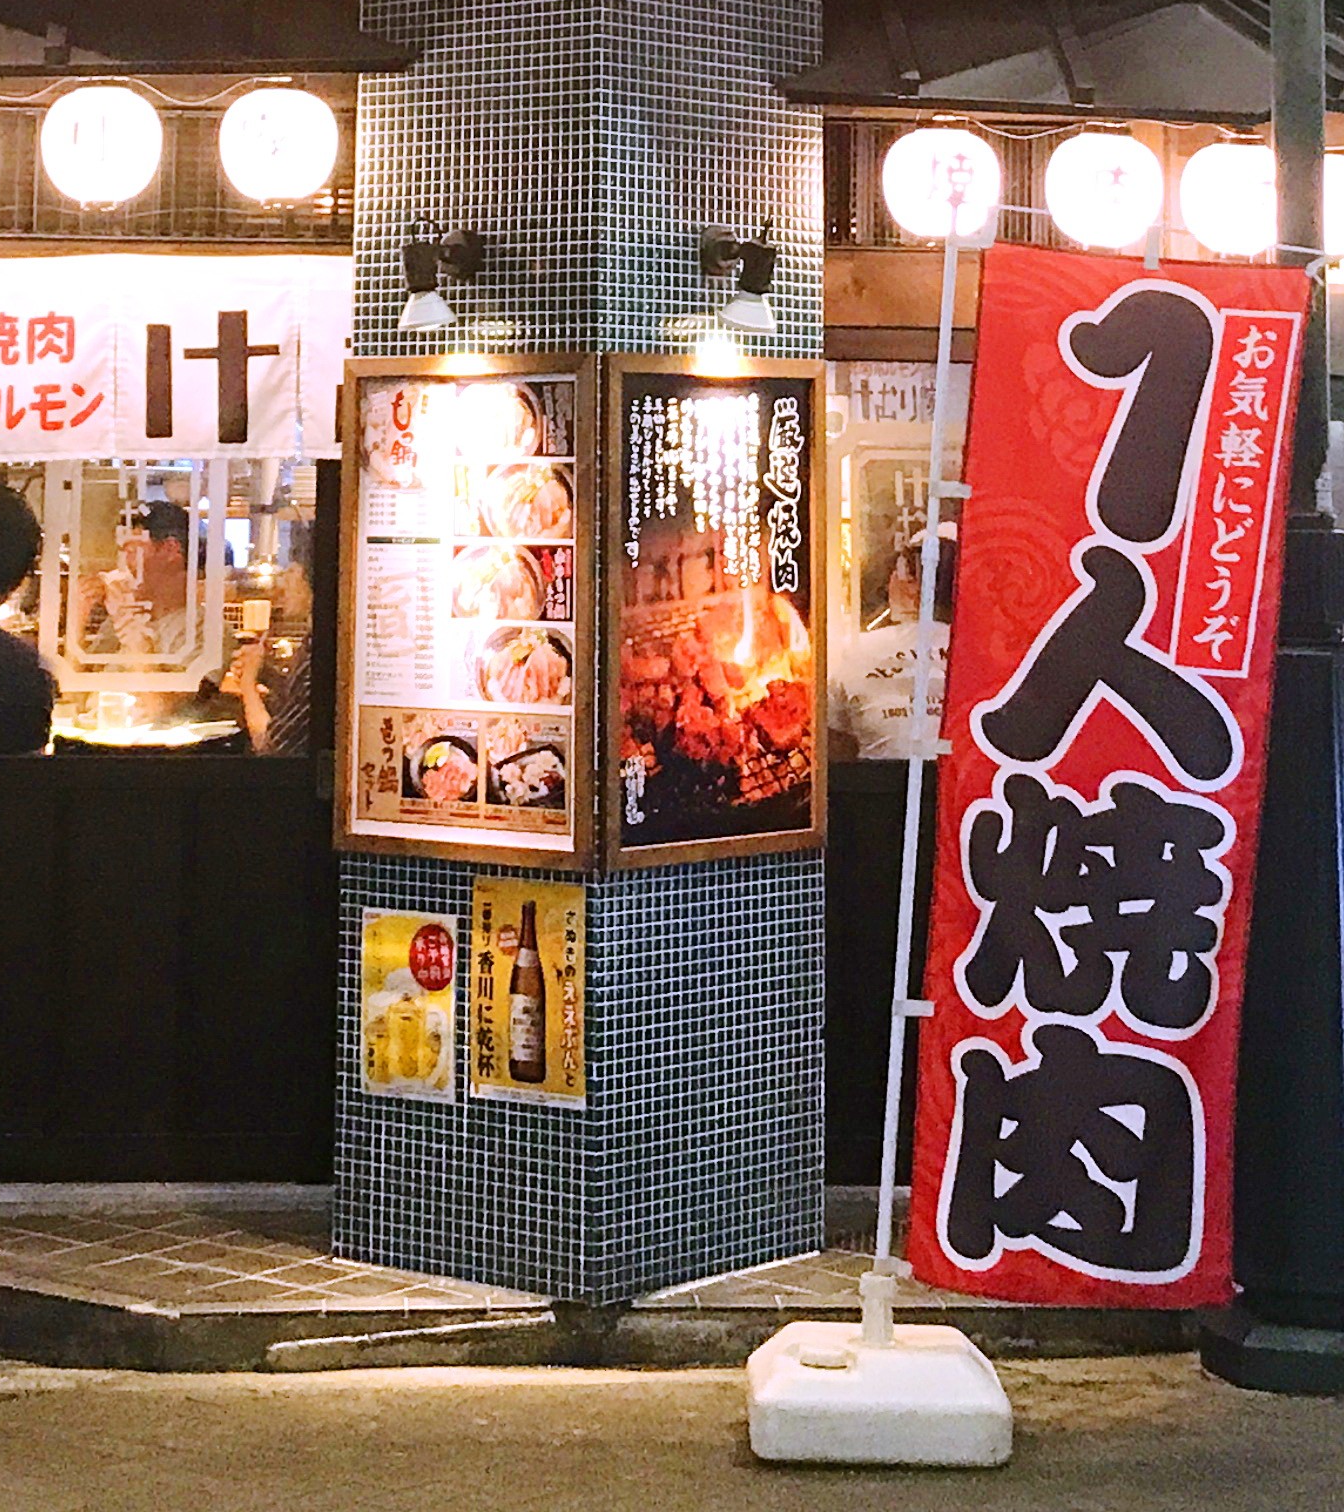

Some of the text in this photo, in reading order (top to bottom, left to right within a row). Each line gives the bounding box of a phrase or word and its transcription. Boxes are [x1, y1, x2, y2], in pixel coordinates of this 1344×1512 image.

[763, 396, 806, 594] 厳選焼肉
[1191, 321, 1280, 668] お気軽にどうぞ
[938, 278, 1246, 1285] 1人焼肉
